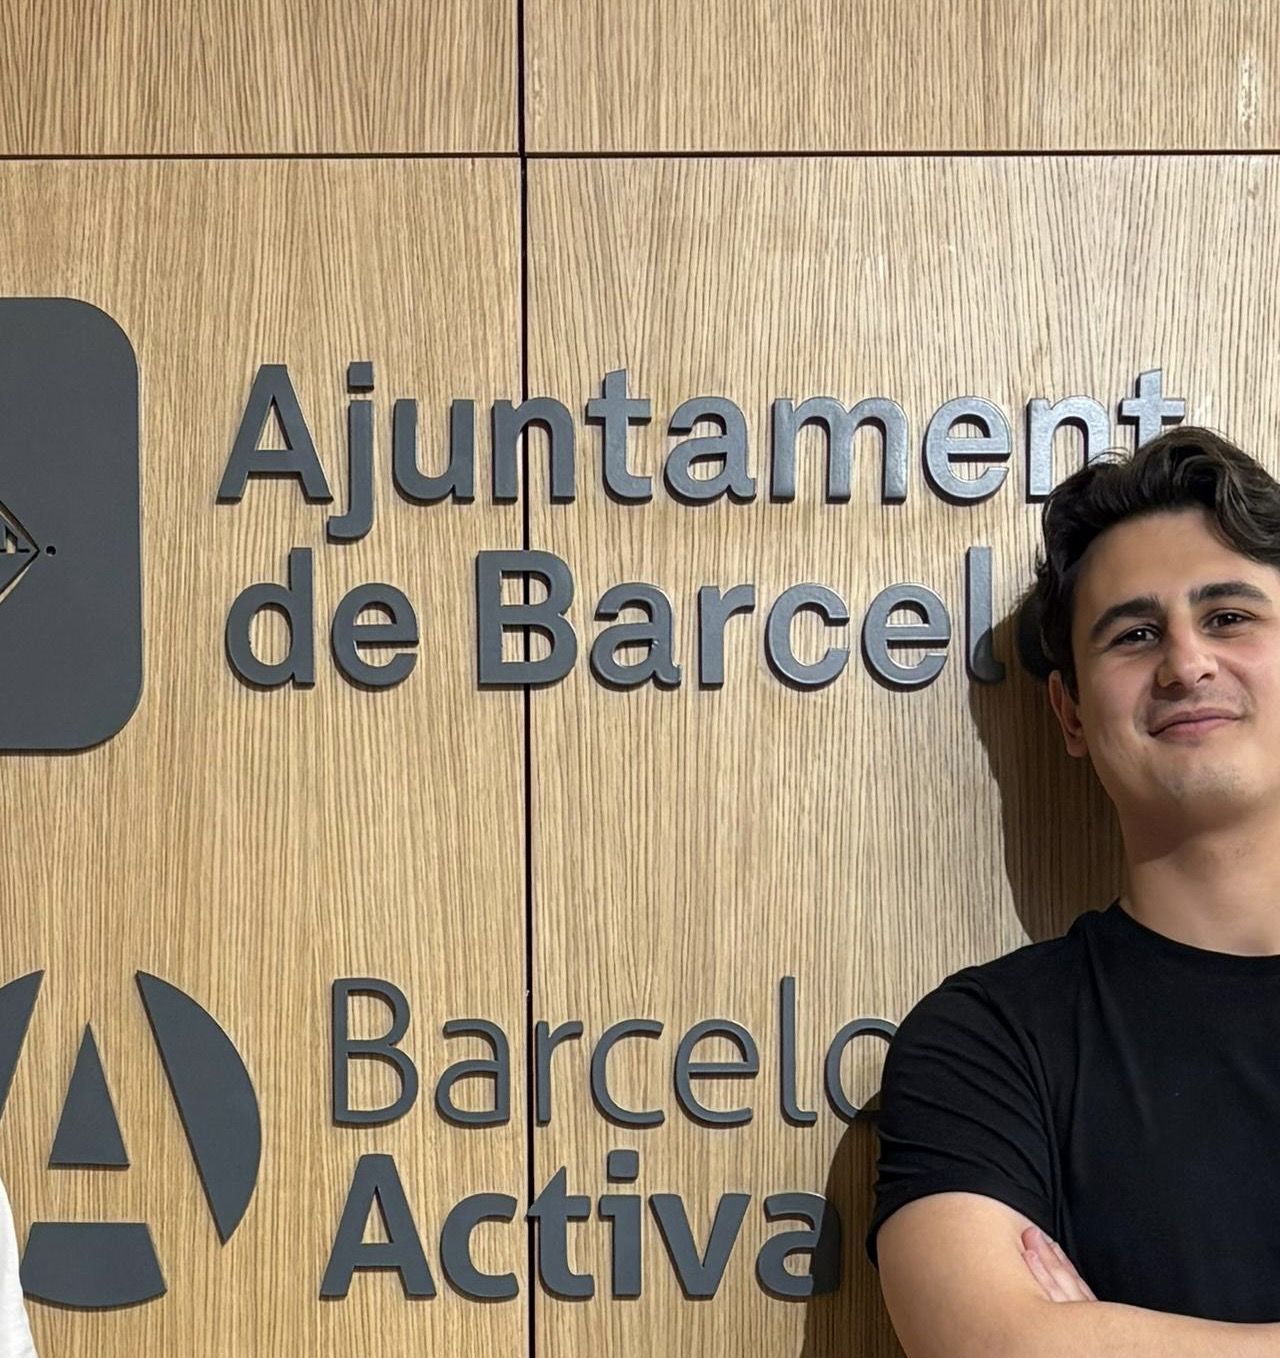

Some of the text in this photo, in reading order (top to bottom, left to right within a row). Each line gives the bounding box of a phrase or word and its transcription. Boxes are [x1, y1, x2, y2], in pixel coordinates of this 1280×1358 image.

[216, 361, 1186, 540] Ajuntament
[224, 546, 419, 689] de
[320, 1148, 841, 1302] Activa
